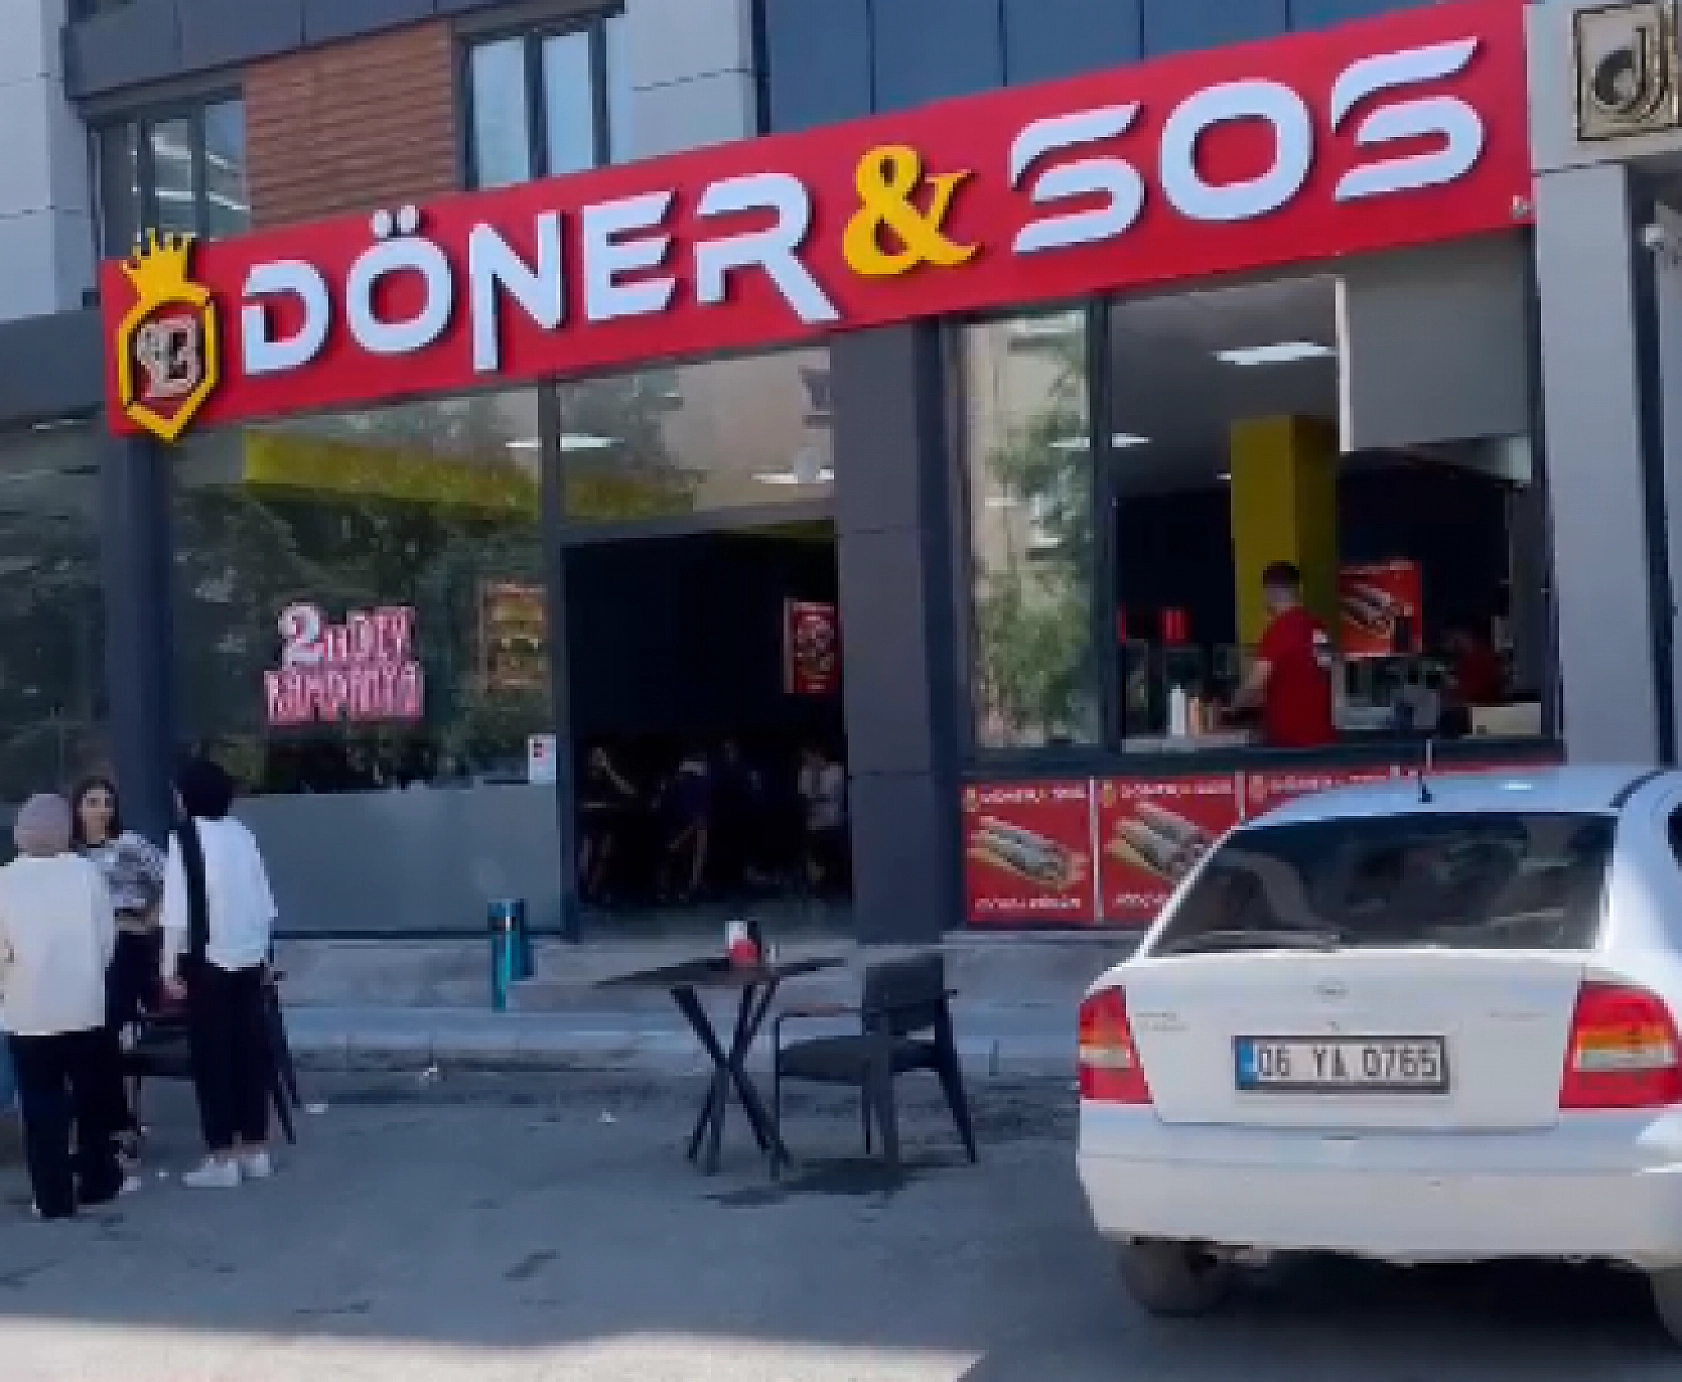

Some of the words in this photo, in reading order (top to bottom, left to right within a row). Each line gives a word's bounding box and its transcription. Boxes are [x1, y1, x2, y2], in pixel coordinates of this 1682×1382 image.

[242, 171, 839, 372] DÖNER
[842, 144, 981, 276] &
[1010, 36, 1484, 253] SOS
[1257, 1047, 1290, 1078] 06
